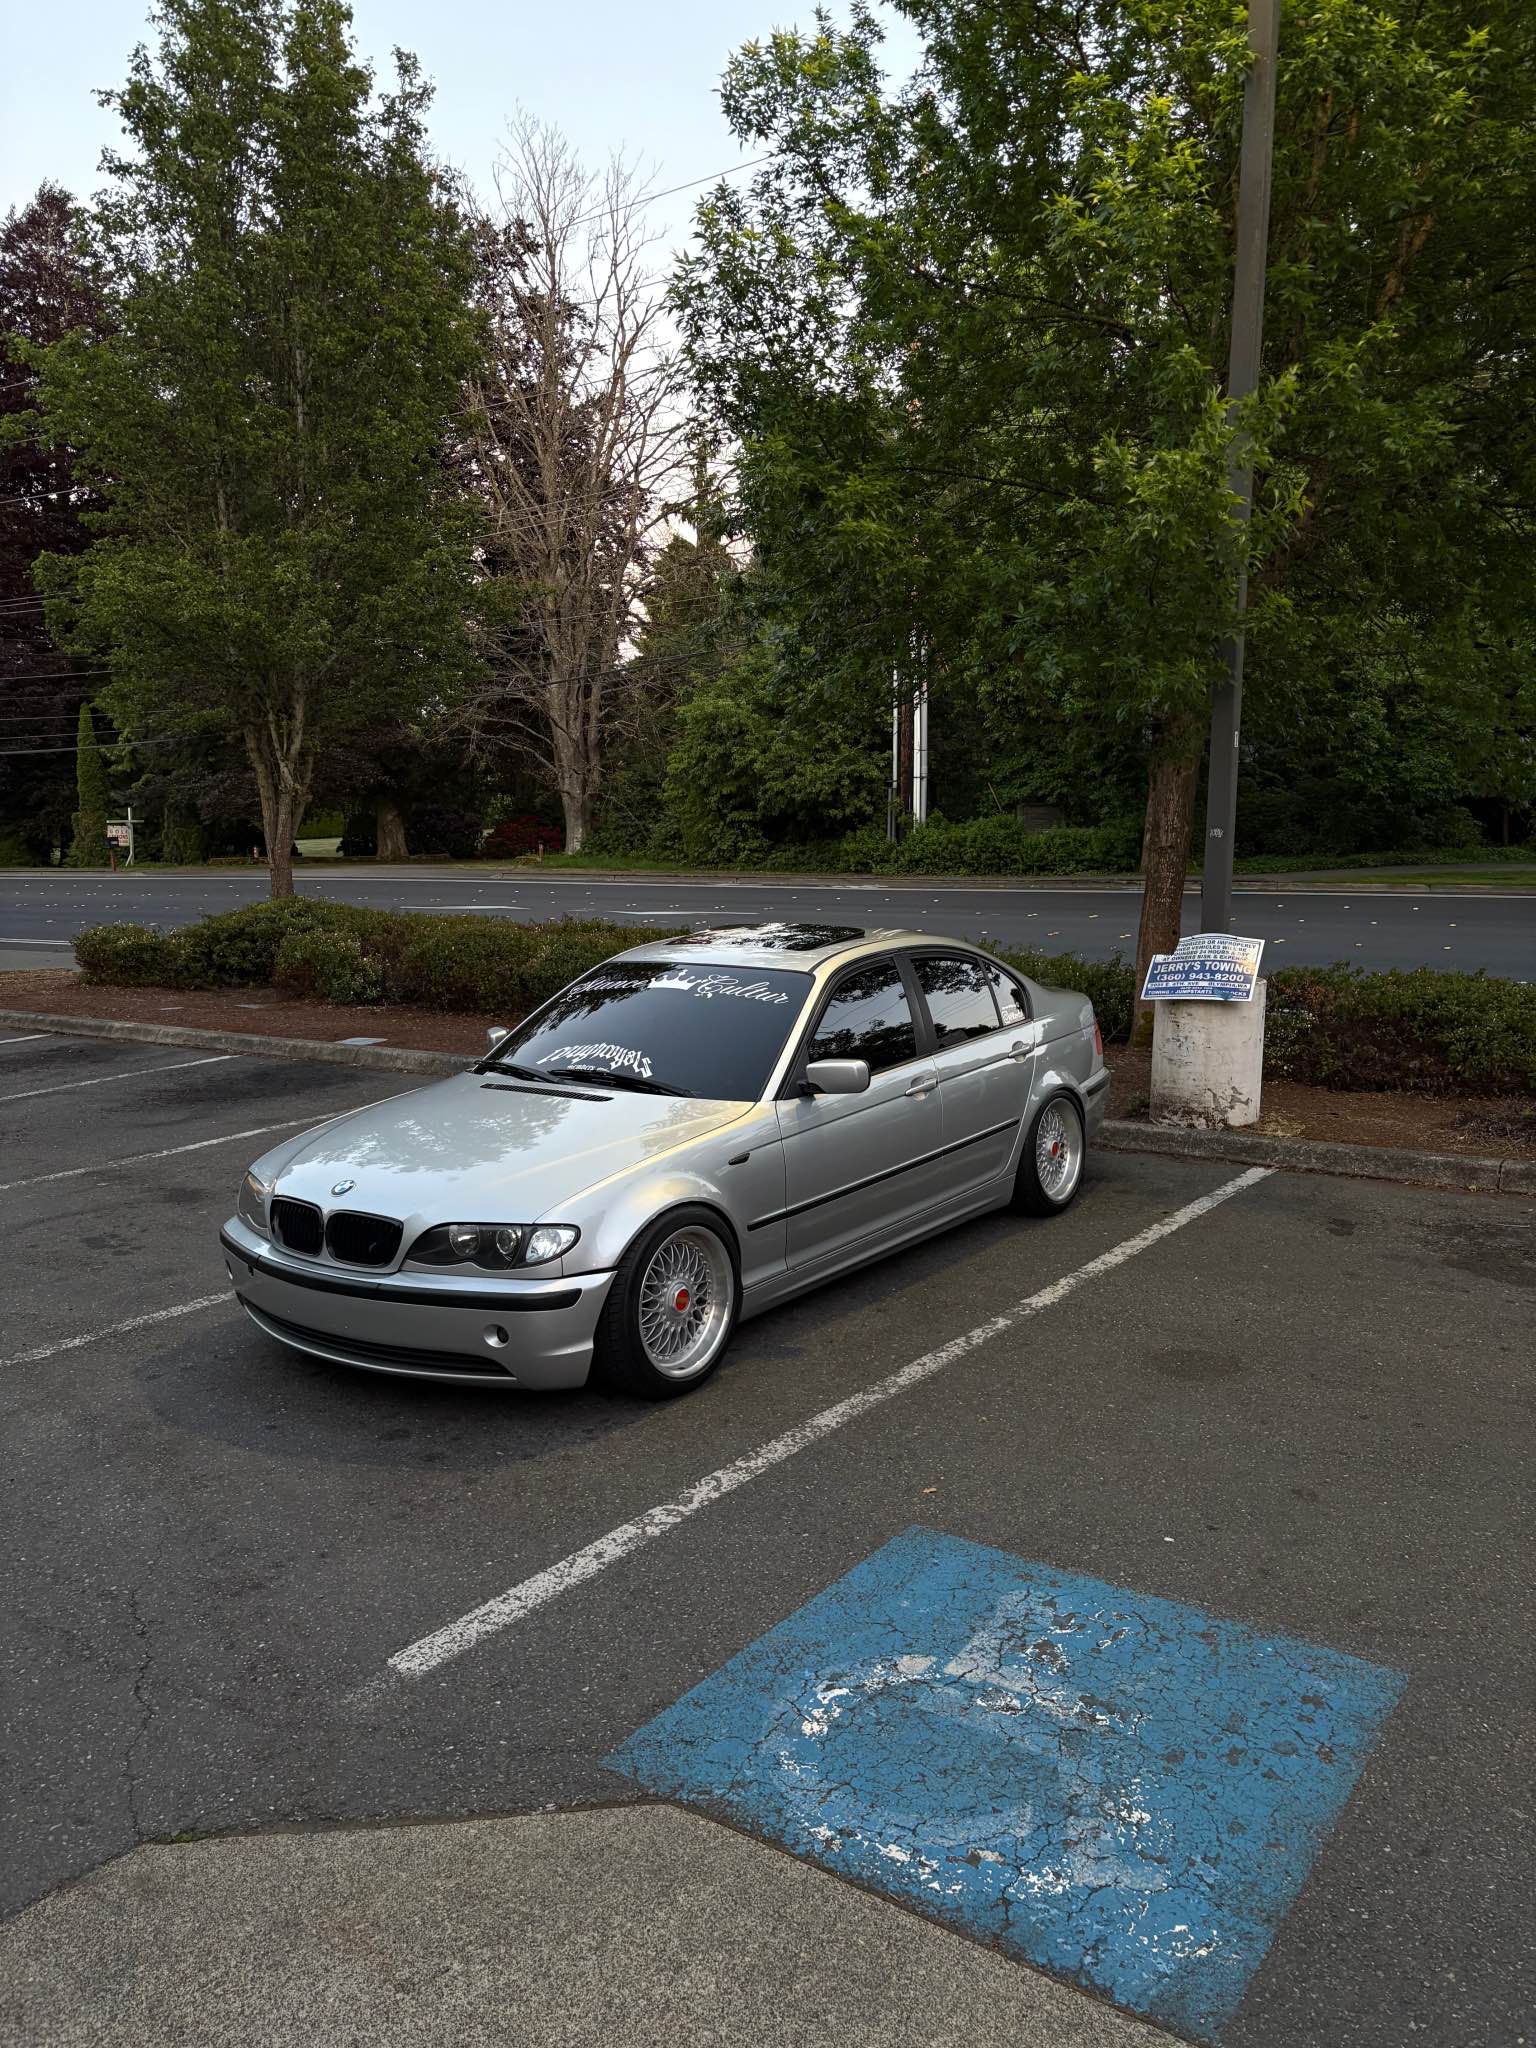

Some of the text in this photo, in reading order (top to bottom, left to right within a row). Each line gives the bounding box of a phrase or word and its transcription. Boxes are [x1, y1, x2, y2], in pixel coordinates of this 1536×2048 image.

[1217, 940, 1257, 949] IMPROPERLY
[1154, 961, 1252, 975] JERRY'S TOWING
[1157, 972, 1244, 982] (360) 943-8200
